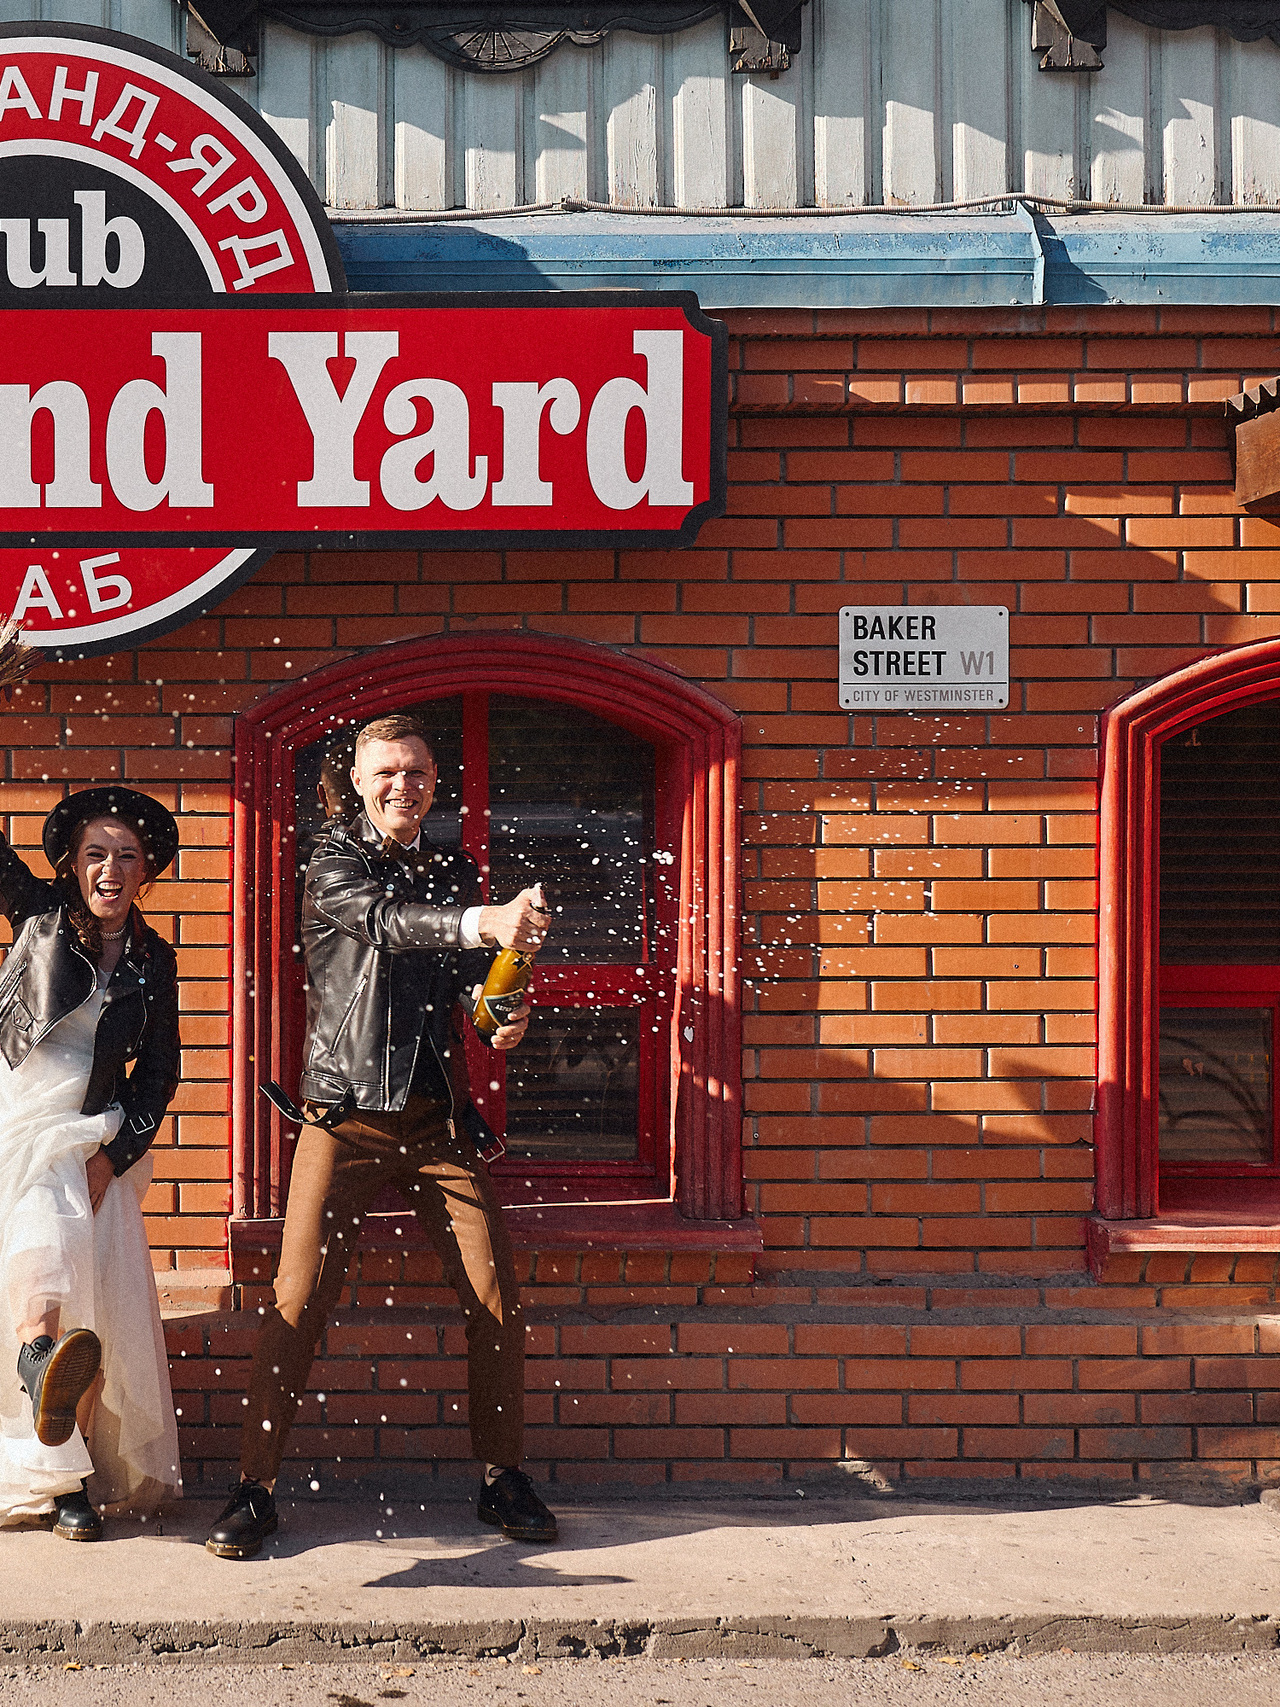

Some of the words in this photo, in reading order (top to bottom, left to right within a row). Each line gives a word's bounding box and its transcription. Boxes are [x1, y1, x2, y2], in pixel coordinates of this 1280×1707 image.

[268, 330, 694, 511] Yard
[853, 615, 936, 641] BAKER
[853, 650, 947, 676] STREET
[959, 650, 994, 675] W1
[853, 690, 880, 702] CITY
[884, 690, 899, 701] OF
[904, 689, 994, 701] WESTMINSTER
